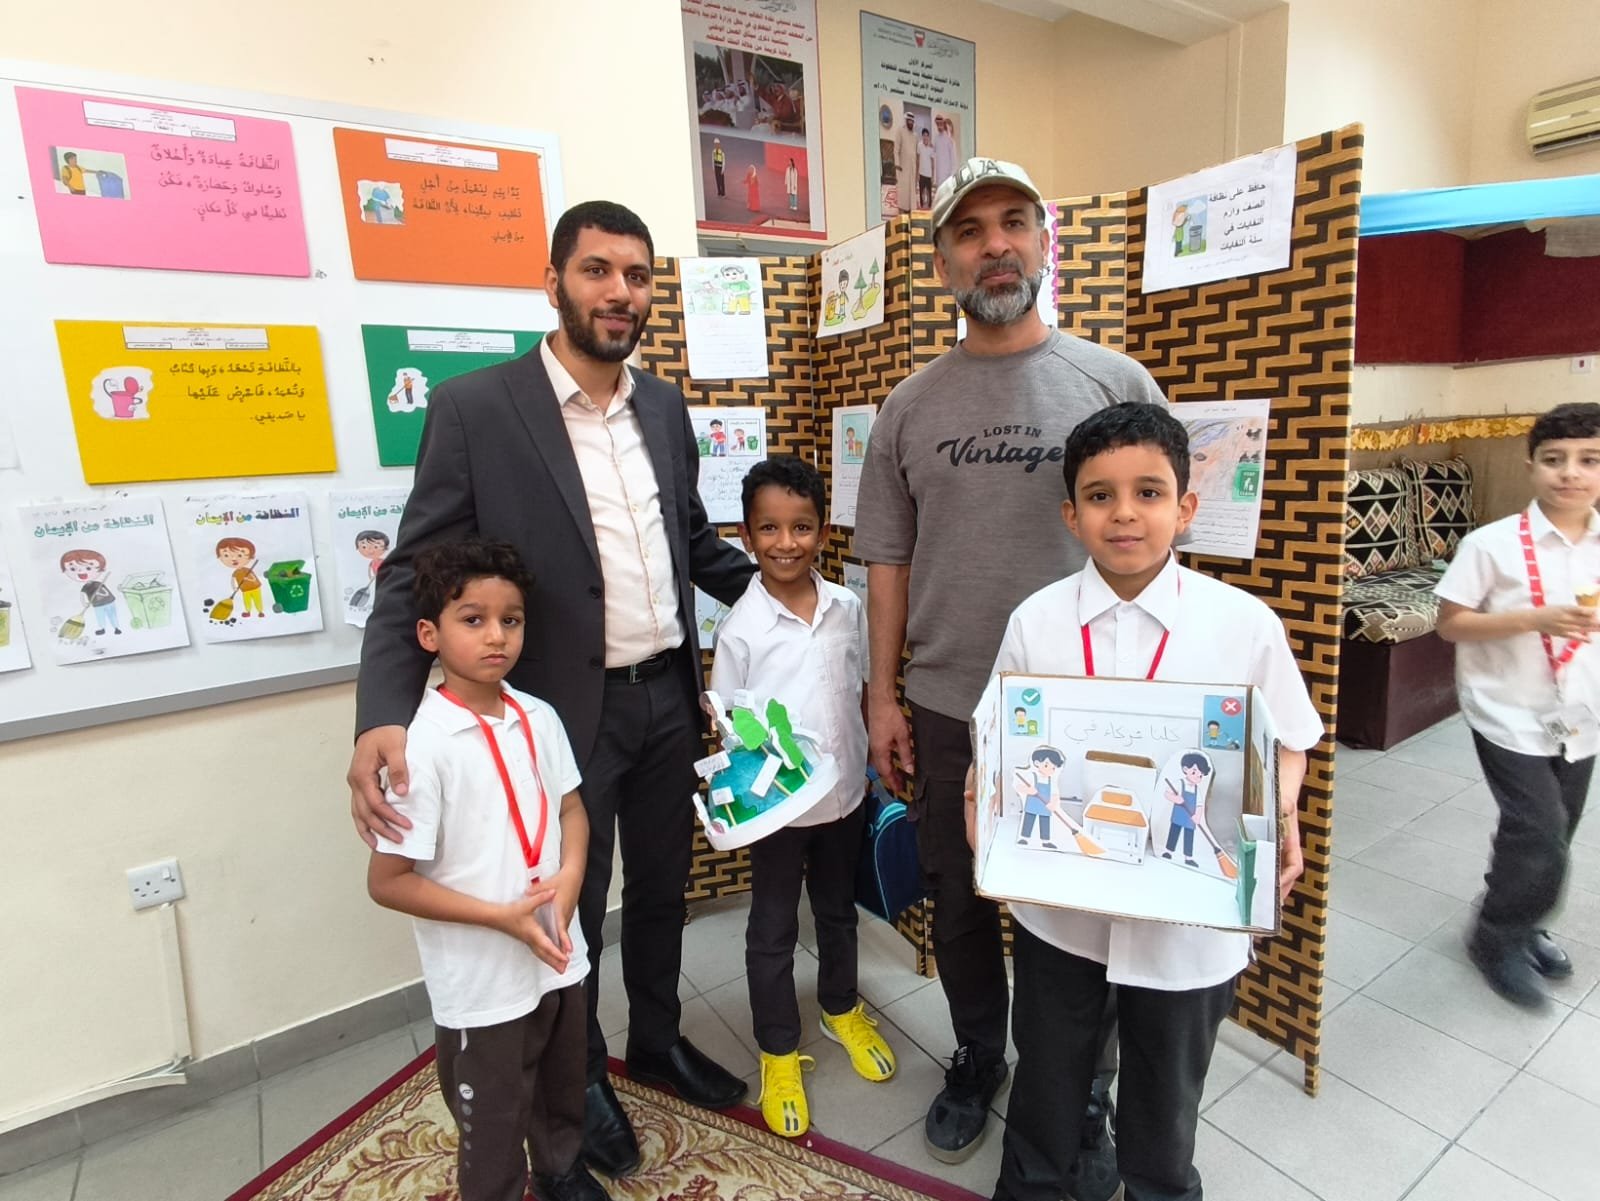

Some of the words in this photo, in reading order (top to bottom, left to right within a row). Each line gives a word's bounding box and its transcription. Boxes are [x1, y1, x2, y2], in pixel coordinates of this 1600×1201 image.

[983, 425, 1022, 438] LOST
[1024, 426, 1043, 438] IN
[936, 436, 1065, 474] Vintage
[236, 511, 252, 523] من
[255, 507, 299, 520] النظافة
